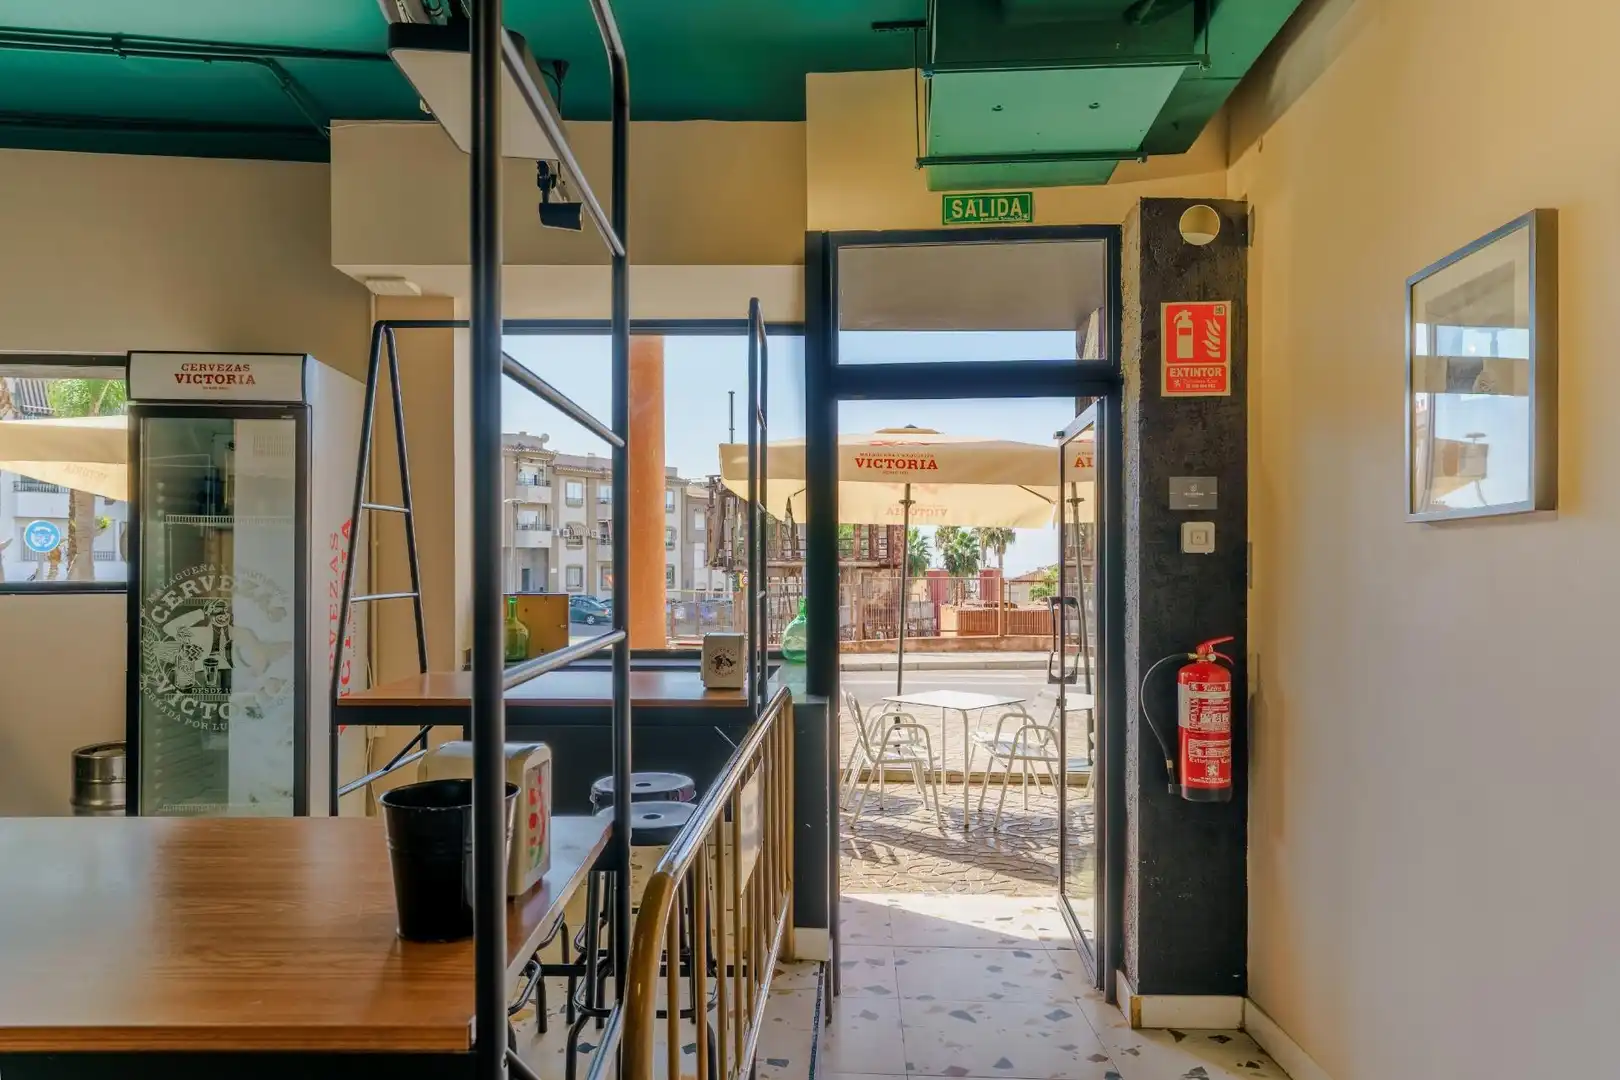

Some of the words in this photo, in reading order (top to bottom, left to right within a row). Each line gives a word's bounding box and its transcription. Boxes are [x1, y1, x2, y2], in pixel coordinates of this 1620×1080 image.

[951, 197, 1023, 218] SALIDA
[181, 363, 251, 372] CERVEZAS
[1169, 367, 1222, 377] EXTINTOR
[174, 373, 256, 385] VICTORIA
[855, 457, 938, 470] VICTORIA
